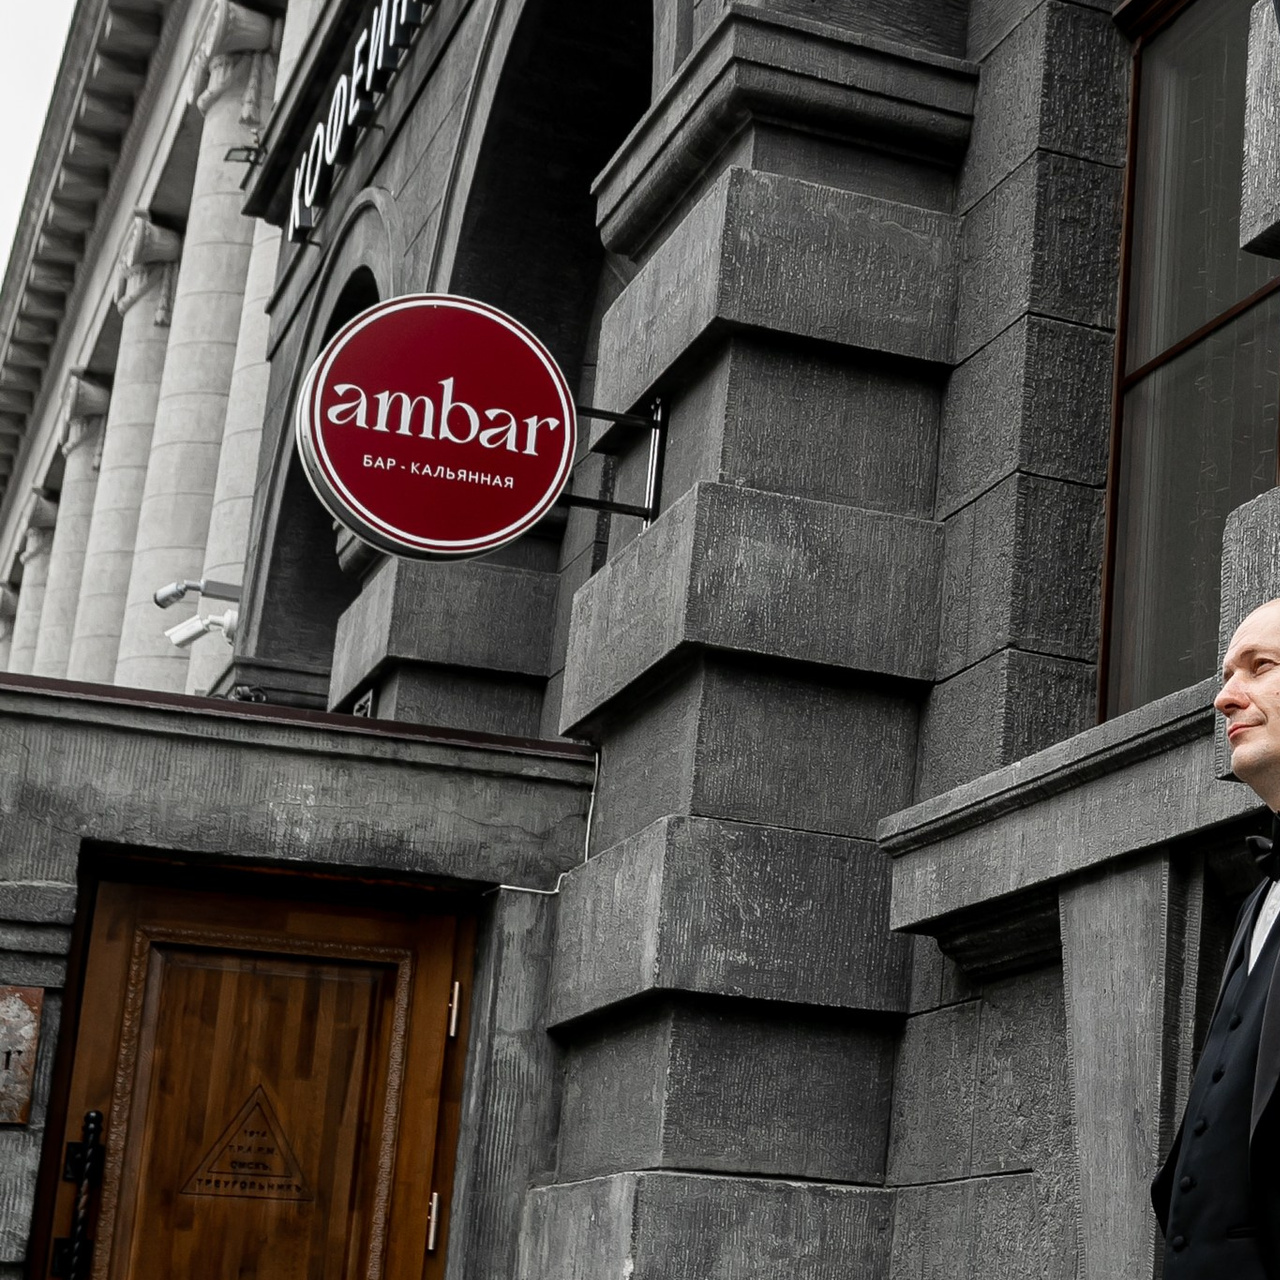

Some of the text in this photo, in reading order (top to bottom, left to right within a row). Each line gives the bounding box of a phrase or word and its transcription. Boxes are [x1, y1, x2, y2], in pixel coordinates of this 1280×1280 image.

[326, 375, 561, 457] ambar
[362, 453, 397, 471] БАР
[410, 461, 515, 490] КАЛЬЯННАЯ
